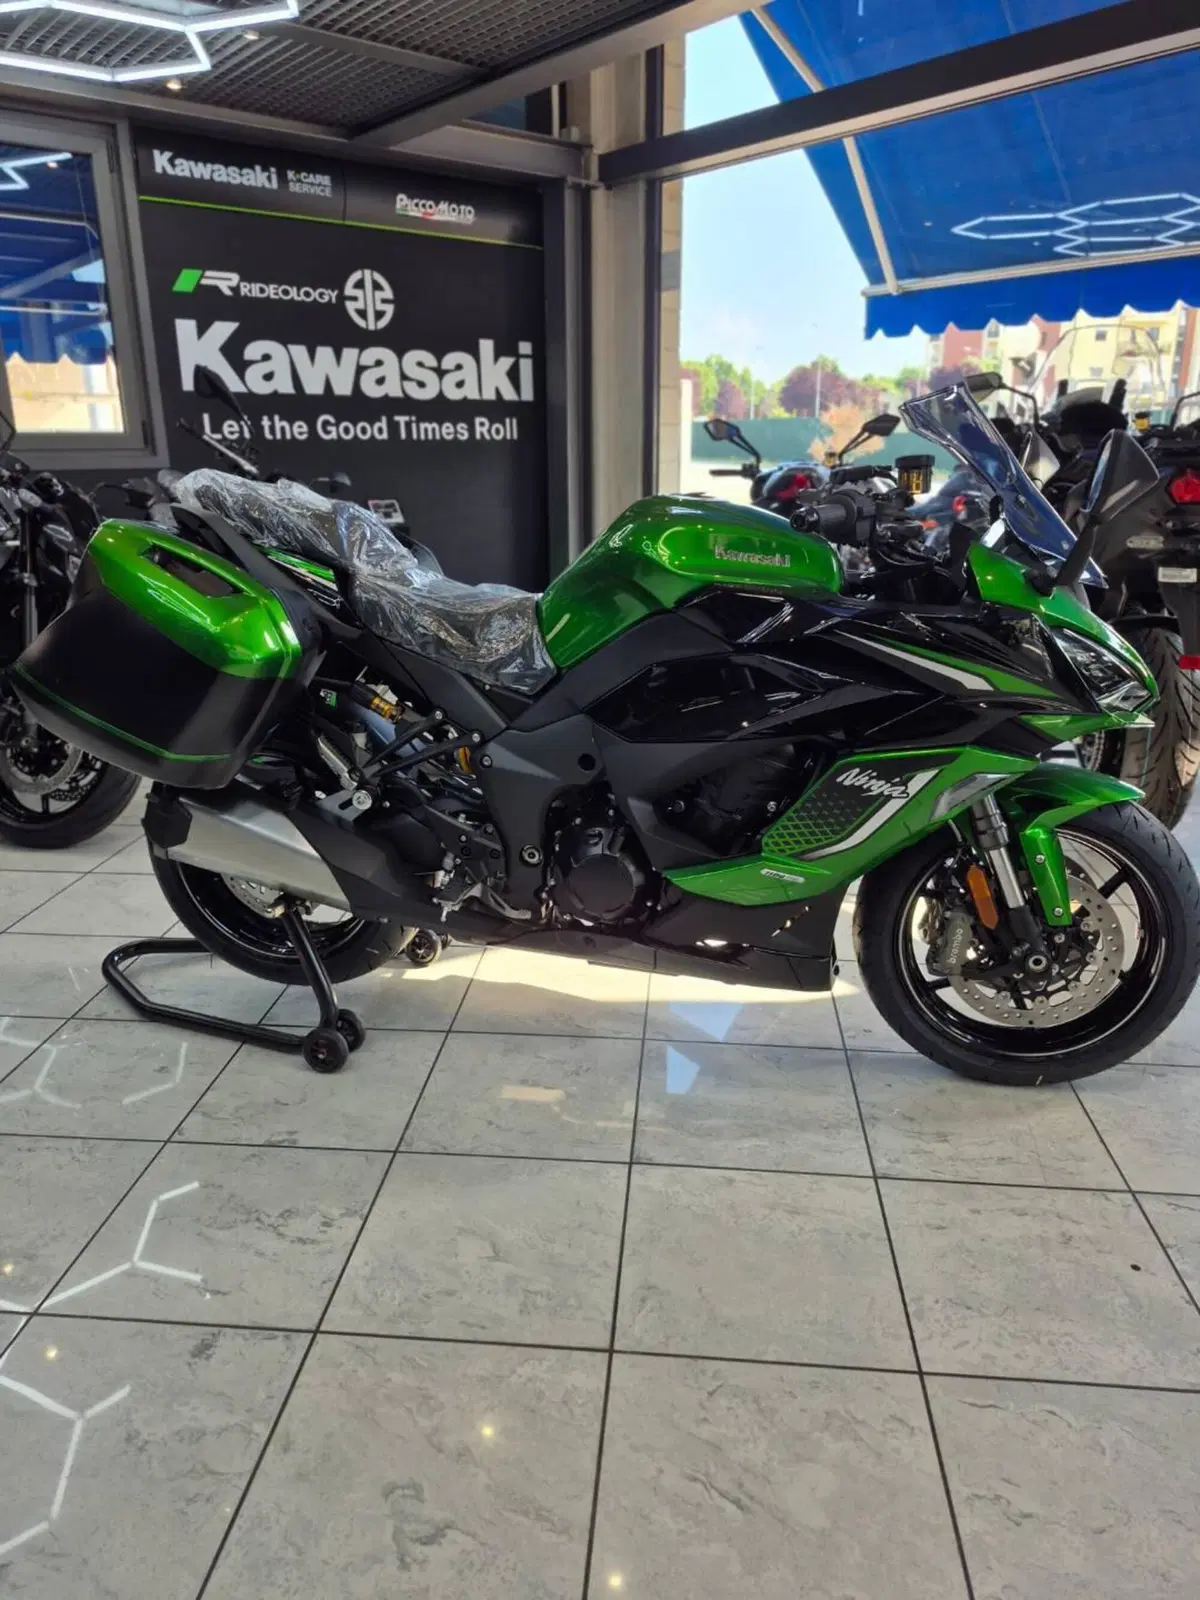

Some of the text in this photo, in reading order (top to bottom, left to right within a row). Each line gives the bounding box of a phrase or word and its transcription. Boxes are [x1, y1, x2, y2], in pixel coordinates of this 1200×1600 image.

[152, 149, 278, 190] Kawasaki
[288, 182, 332, 197] SERVICE
[240, 281, 339, 304] RIDEOLOGY
[174, 318, 534, 401] Kawasaki
[261, 414, 308, 440] the
[316, 413, 389, 441] Good
[394, 415, 469, 441] Times
[475, 415, 519, 441] Roll
[715, 544, 791, 568] Kawasaki
[836, 767, 908, 797] Ninja
